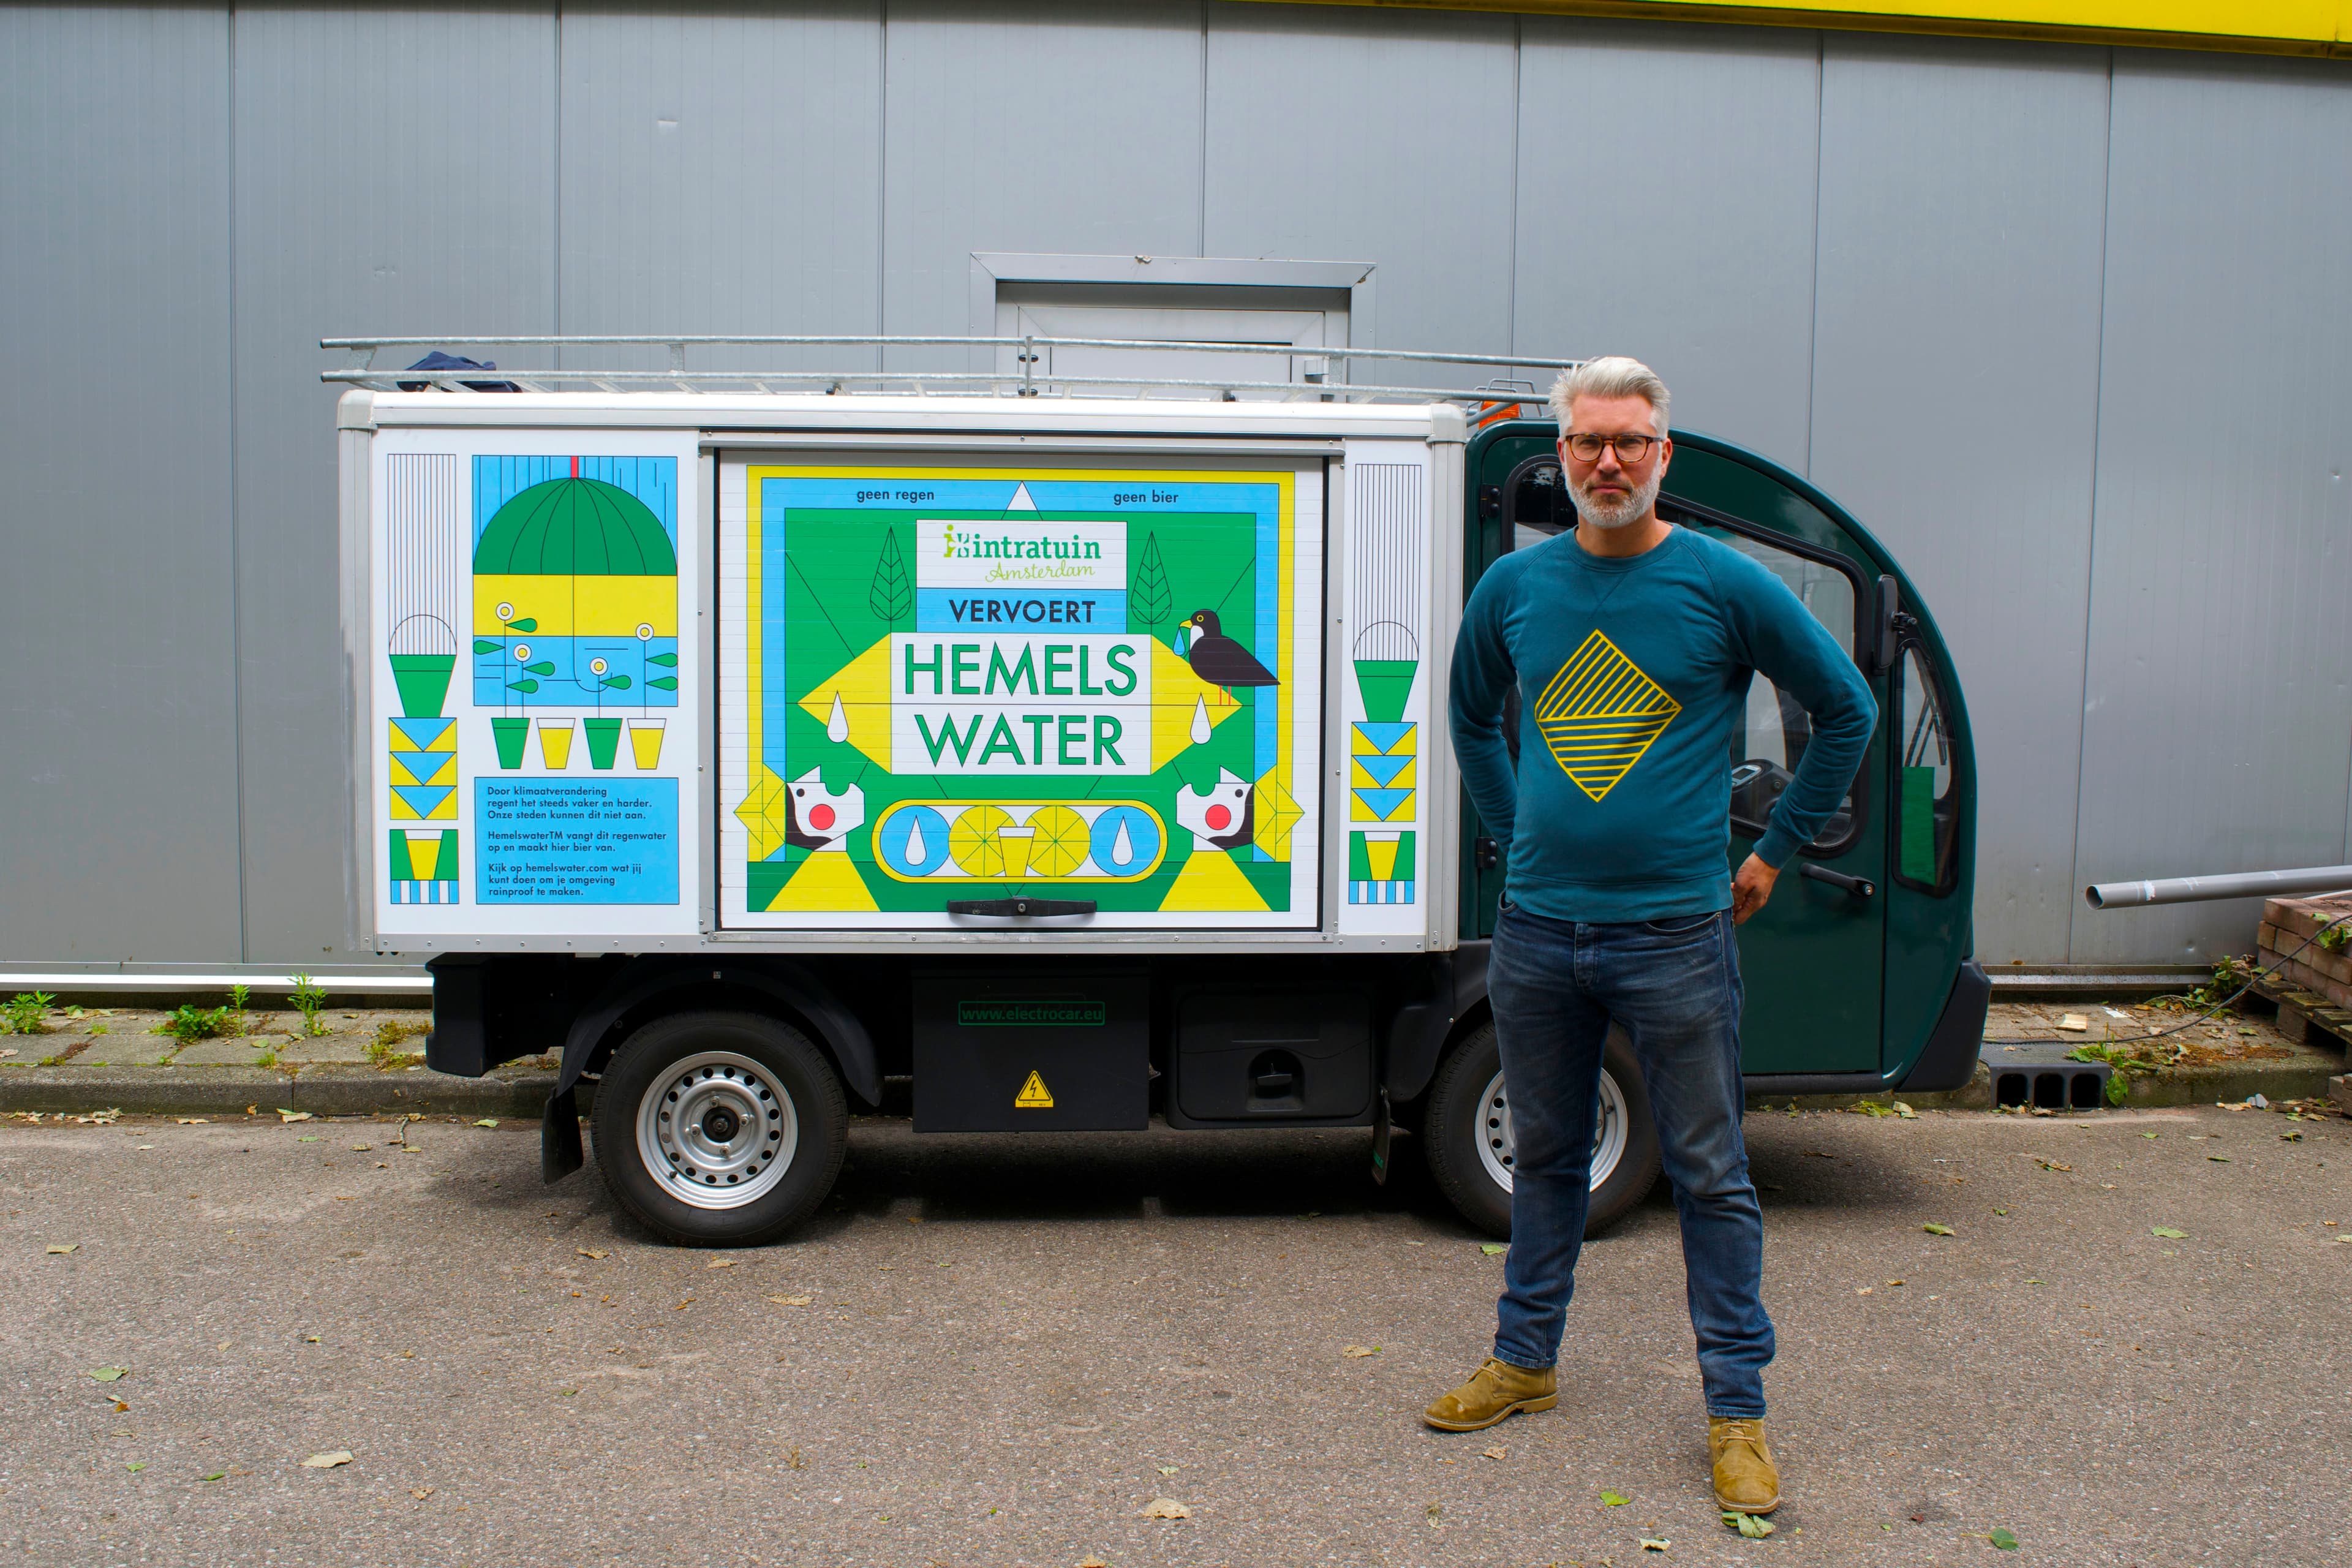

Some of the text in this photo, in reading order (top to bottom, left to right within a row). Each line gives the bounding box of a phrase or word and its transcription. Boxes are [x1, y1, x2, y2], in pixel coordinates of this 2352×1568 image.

[857, 490, 934, 503] geen regen
[1114, 489, 1179, 506] geen bier
[972, 533, 1101, 559] intratuin
[984, 559, 1095, 582] Amsterdam
[949, 599, 1096, 624] VERVOERT
[905, 641, 1137, 697] HEMELS
[913, 712, 1126, 768] WATER
[488, 786, 607, 797] Door klimaatverandering
[488, 799, 518, 809] regent
[521, 797, 537, 807] het
[539, 797, 569, 807] steeds
[572, 797, 599, 807] vaker
[617, 797, 652, 807] harder.
[488, 810, 513, 819] Onze
[516, 809, 546, 819] steden
[550, 809, 584, 819] kunnen
[588, 810, 601, 819] dit
[604, 810, 622, 819] niet
[488, 830, 667, 842] HemelswaterTM vangt dit regenwater
[488, 845, 500, 854] op
[519, 842, 548, 851] maakt
[551, 842, 570, 851] hier
[573, 842, 592, 851] bier
[489, 862, 641, 875] Kijk op hemelswater.com wat jij
[489, 874, 510, 884] kunt
[513, 874, 536, 884] doen
[557, 875, 566, 886] je
[569, 875, 615, 886] omgeving
[489, 886, 534, 898] rainproof
[549, 886, 584, 895] maken.
[962, 1006, 1102, 1020] www.electrocar.eu
